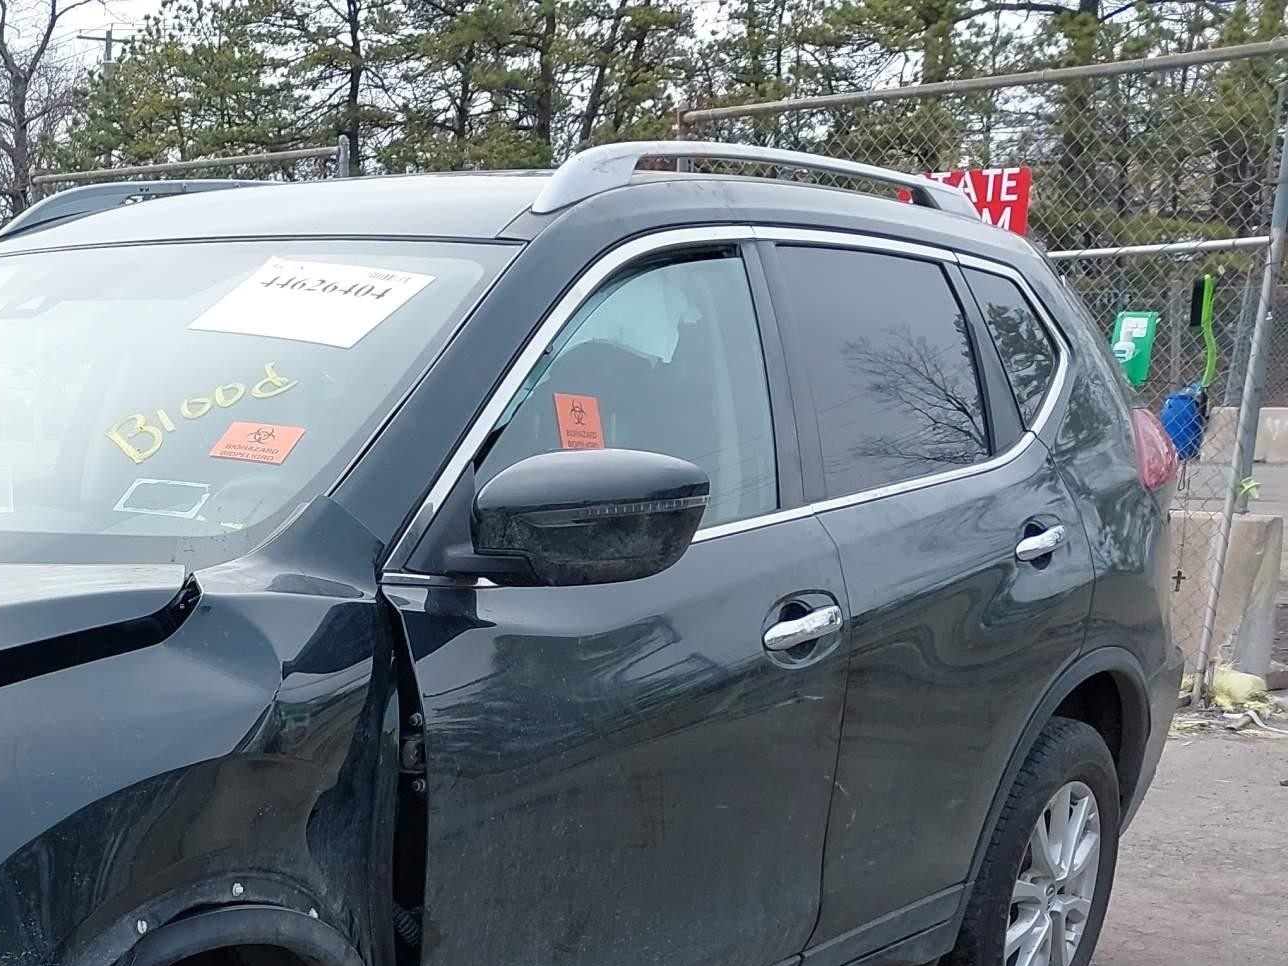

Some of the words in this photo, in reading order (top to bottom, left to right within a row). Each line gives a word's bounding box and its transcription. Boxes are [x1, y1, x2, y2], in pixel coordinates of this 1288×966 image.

[259, 275, 393, 300] 44626404
[104, 362, 299, 464] Blood
[219, 450, 275, 462] BIOPELIGRO
[224, 443, 280, 455] BIOHAZARD
